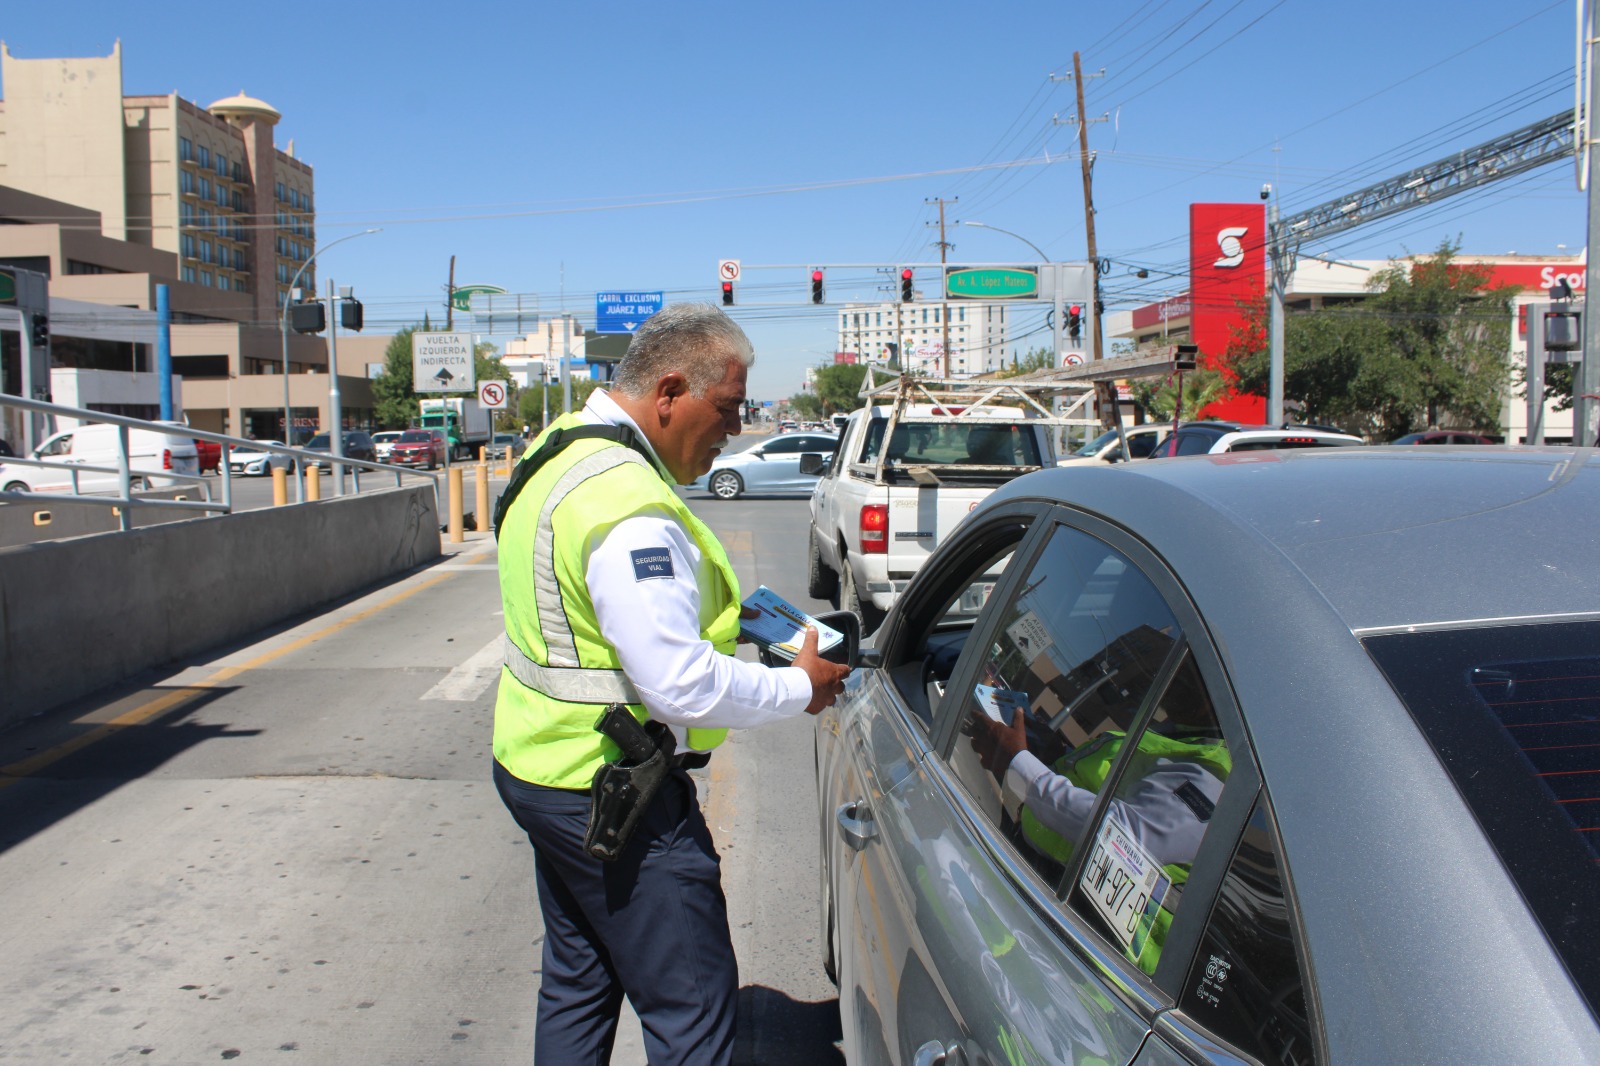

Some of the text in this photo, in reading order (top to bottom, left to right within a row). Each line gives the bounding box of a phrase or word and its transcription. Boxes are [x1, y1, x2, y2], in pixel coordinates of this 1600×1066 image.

[598, 294, 661, 303] CARRIL EXCLUSIVO
[605, 304, 654, 315] JUÁREZ BUS
[426, 336, 459, 345] VUELTA
[419, 347, 467, 355] IZQUIERDA
[420, 357, 466, 366] INDIRECTA
[635, 555, 670, 565] SEGURIDAD
[648, 564, 664, 572] VIAL
